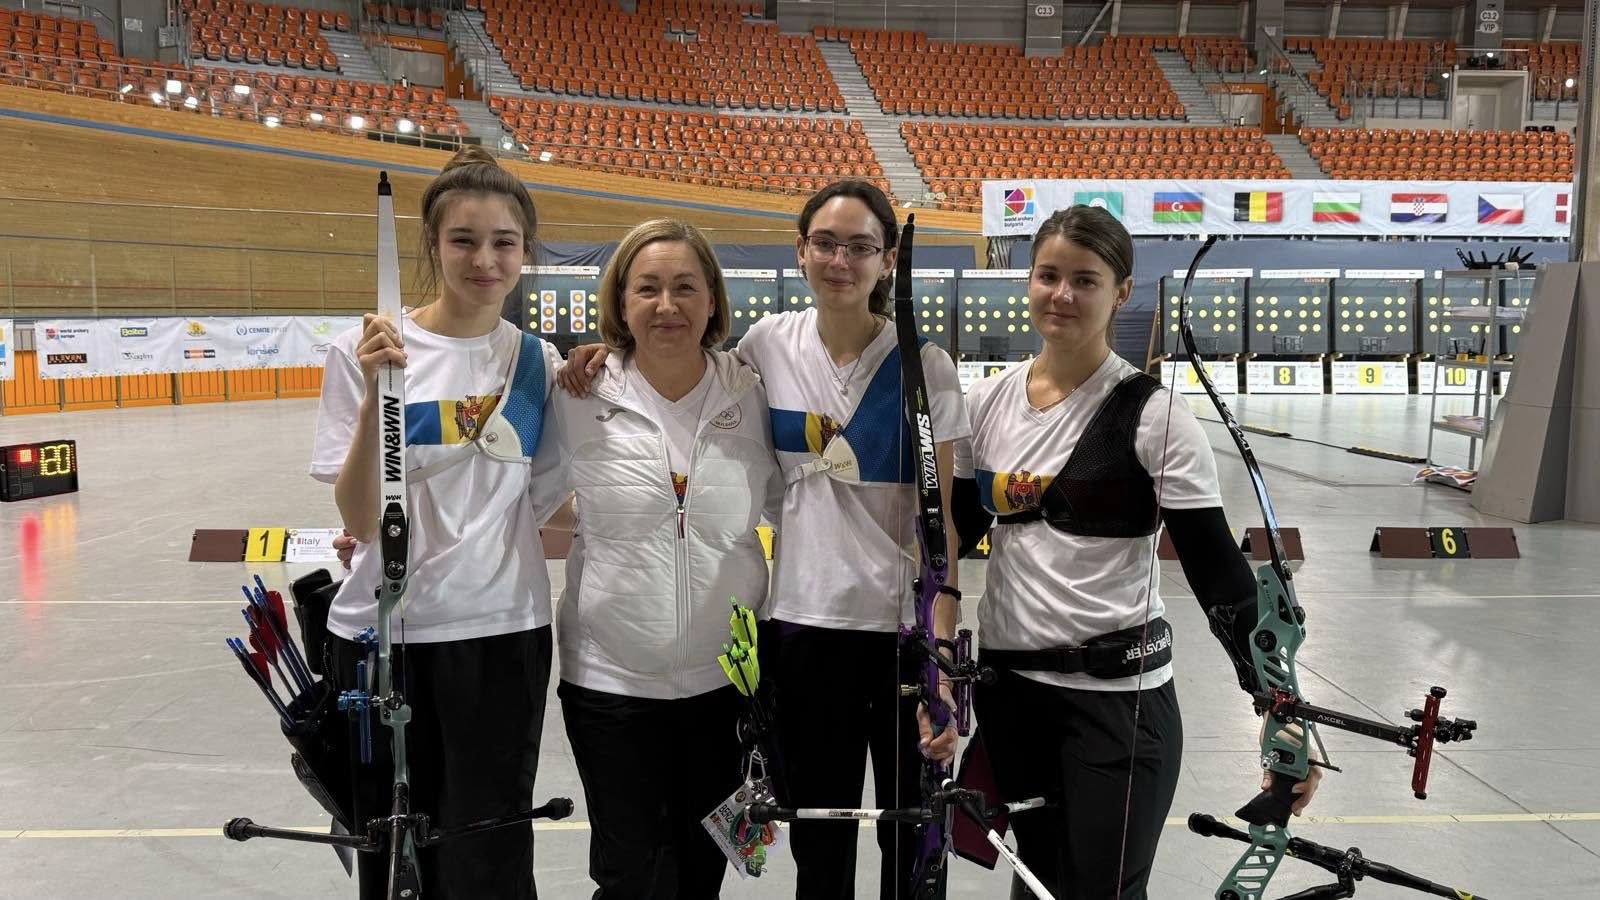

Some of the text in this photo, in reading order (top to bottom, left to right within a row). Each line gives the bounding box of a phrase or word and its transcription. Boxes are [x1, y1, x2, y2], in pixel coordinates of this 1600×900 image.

[1482, 11, 1497, 20] C3.2
[1483, 23, 1496, 31] VIP
[1279, 367, 1290, 385] 8
[1365, 367, 1375, 384] 9
[1445, 367, 1466, 386] 10
[383, 395, 402, 483] WIN&WIN
[916, 412, 939, 489] WIAWIS
[259, 530, 270, 557] 1
[301, 536, 321, 547] Italy
[976, 534, 990, 555] 4
[1441, 528, 1457, 555] 6
[1317, 714, 1346, 726] AXCEL
